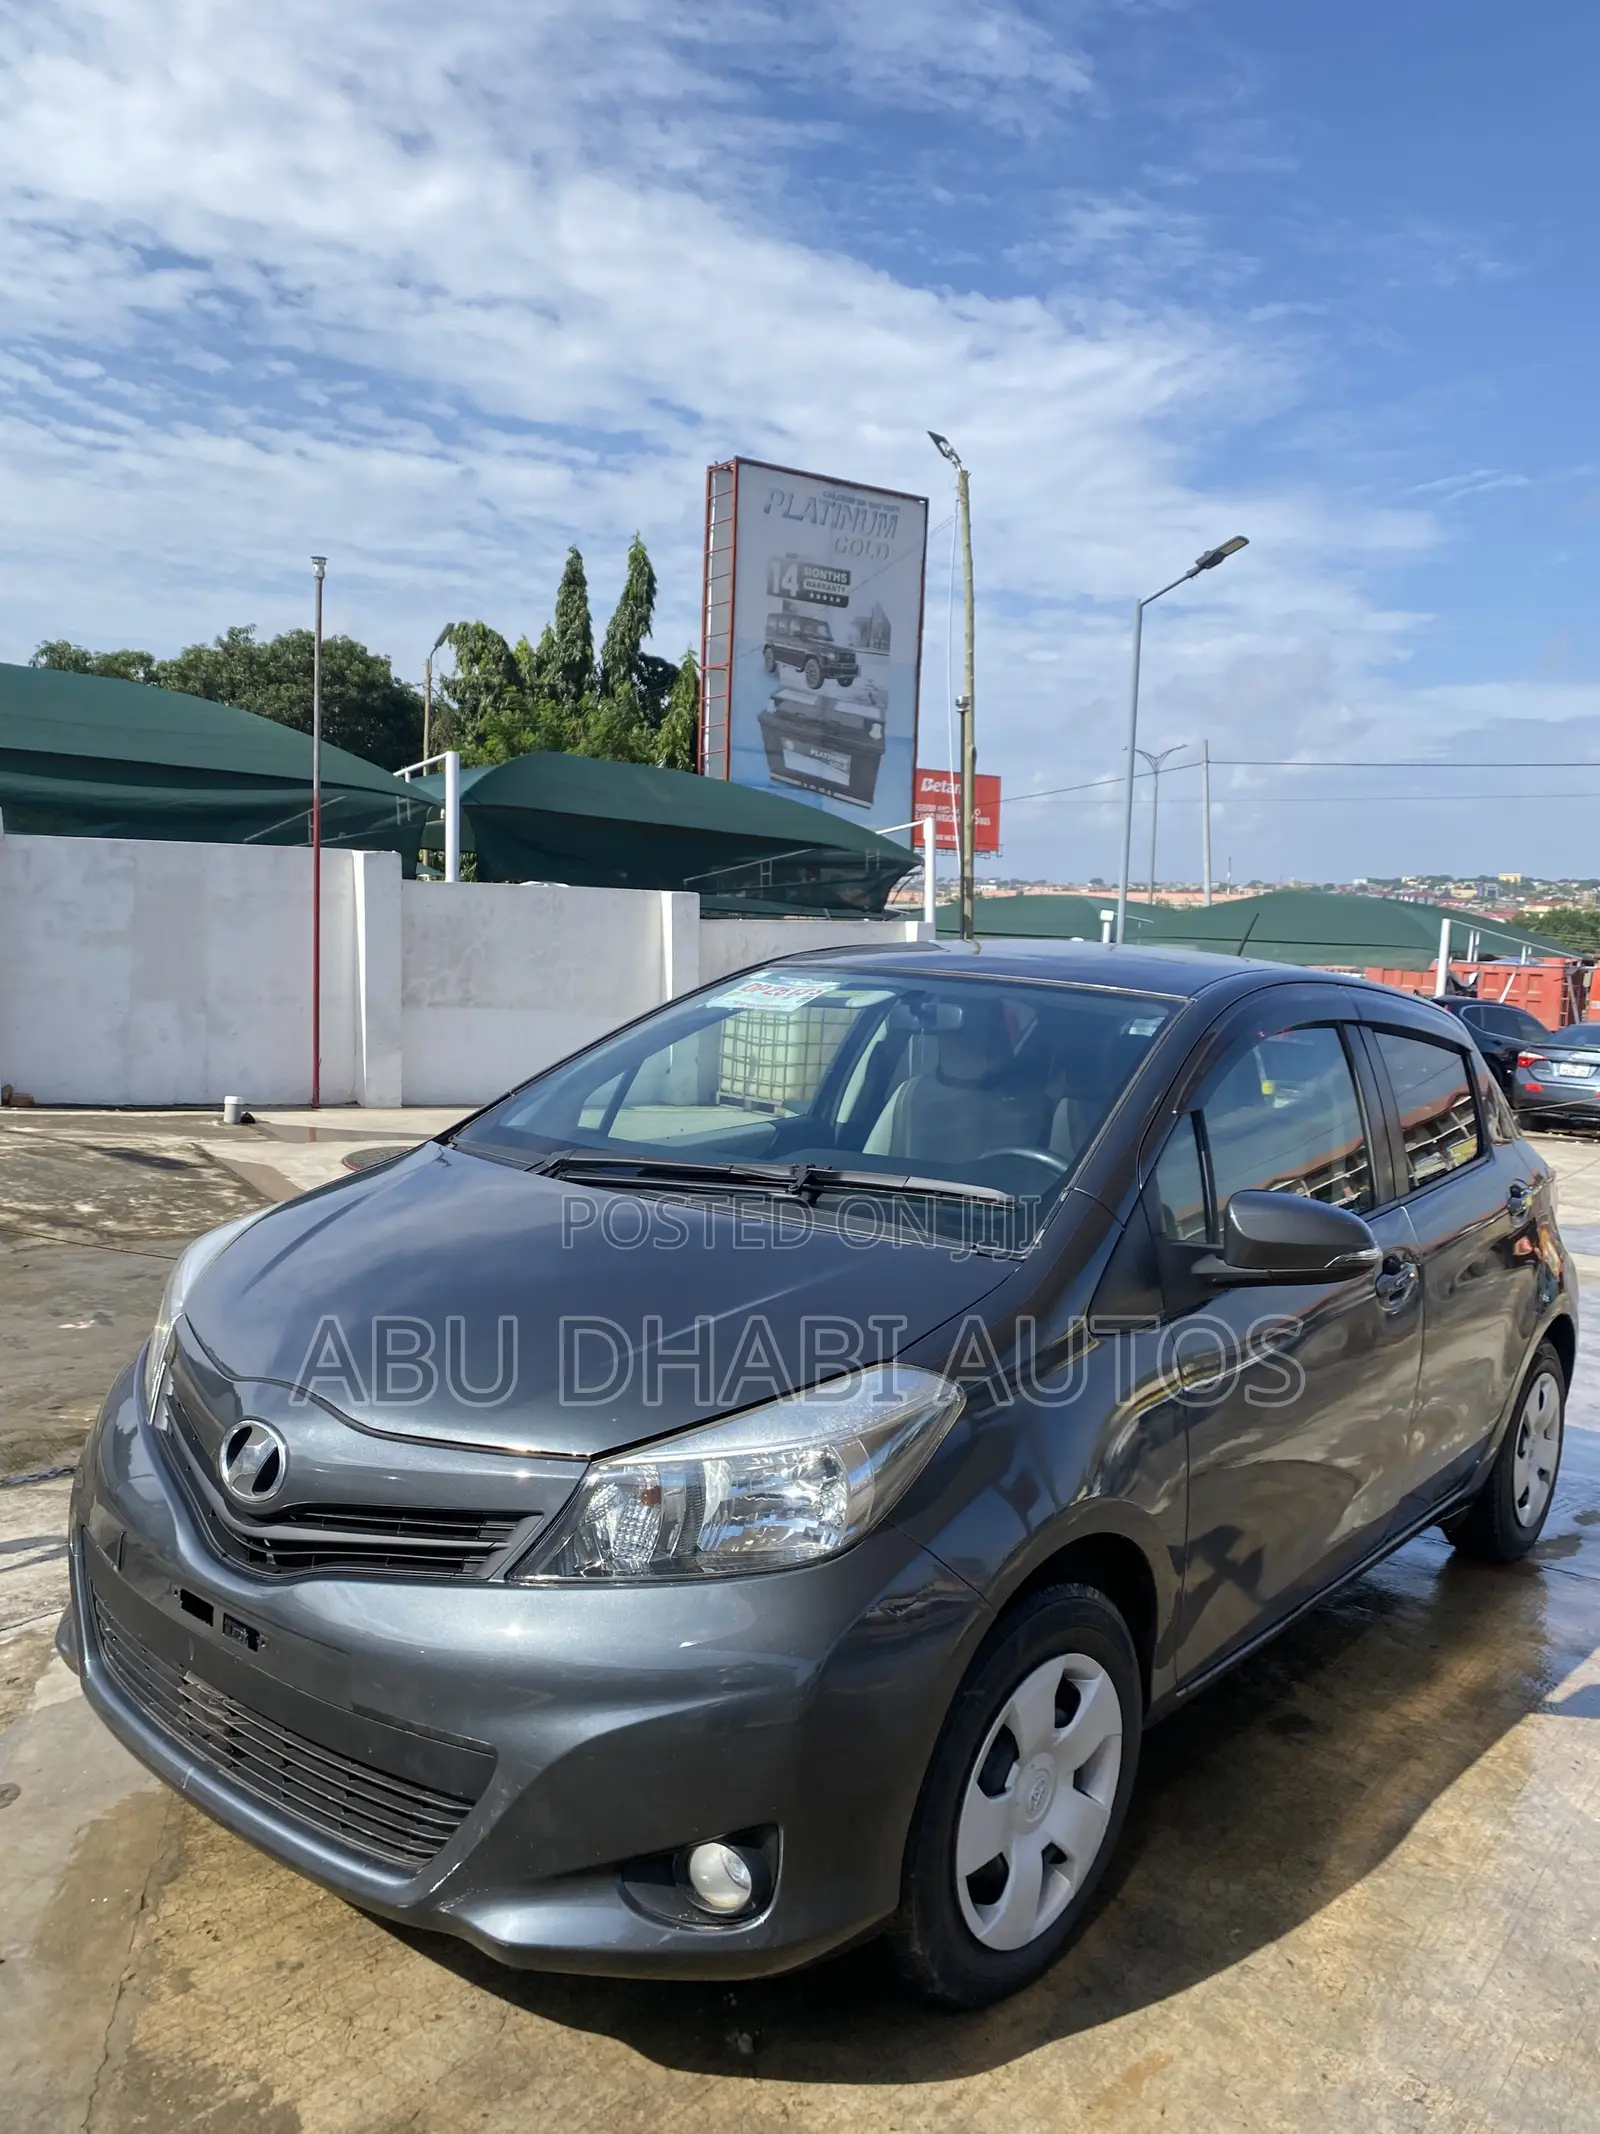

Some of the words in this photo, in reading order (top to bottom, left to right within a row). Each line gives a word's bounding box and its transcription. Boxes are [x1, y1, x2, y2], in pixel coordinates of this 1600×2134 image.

[763, 488, 898, 539] PLATINUM
[835, 536, 890, 560] GOLD
[770, 560, 800, 597] 14
[803, 566, 848, 584] MONTHS
